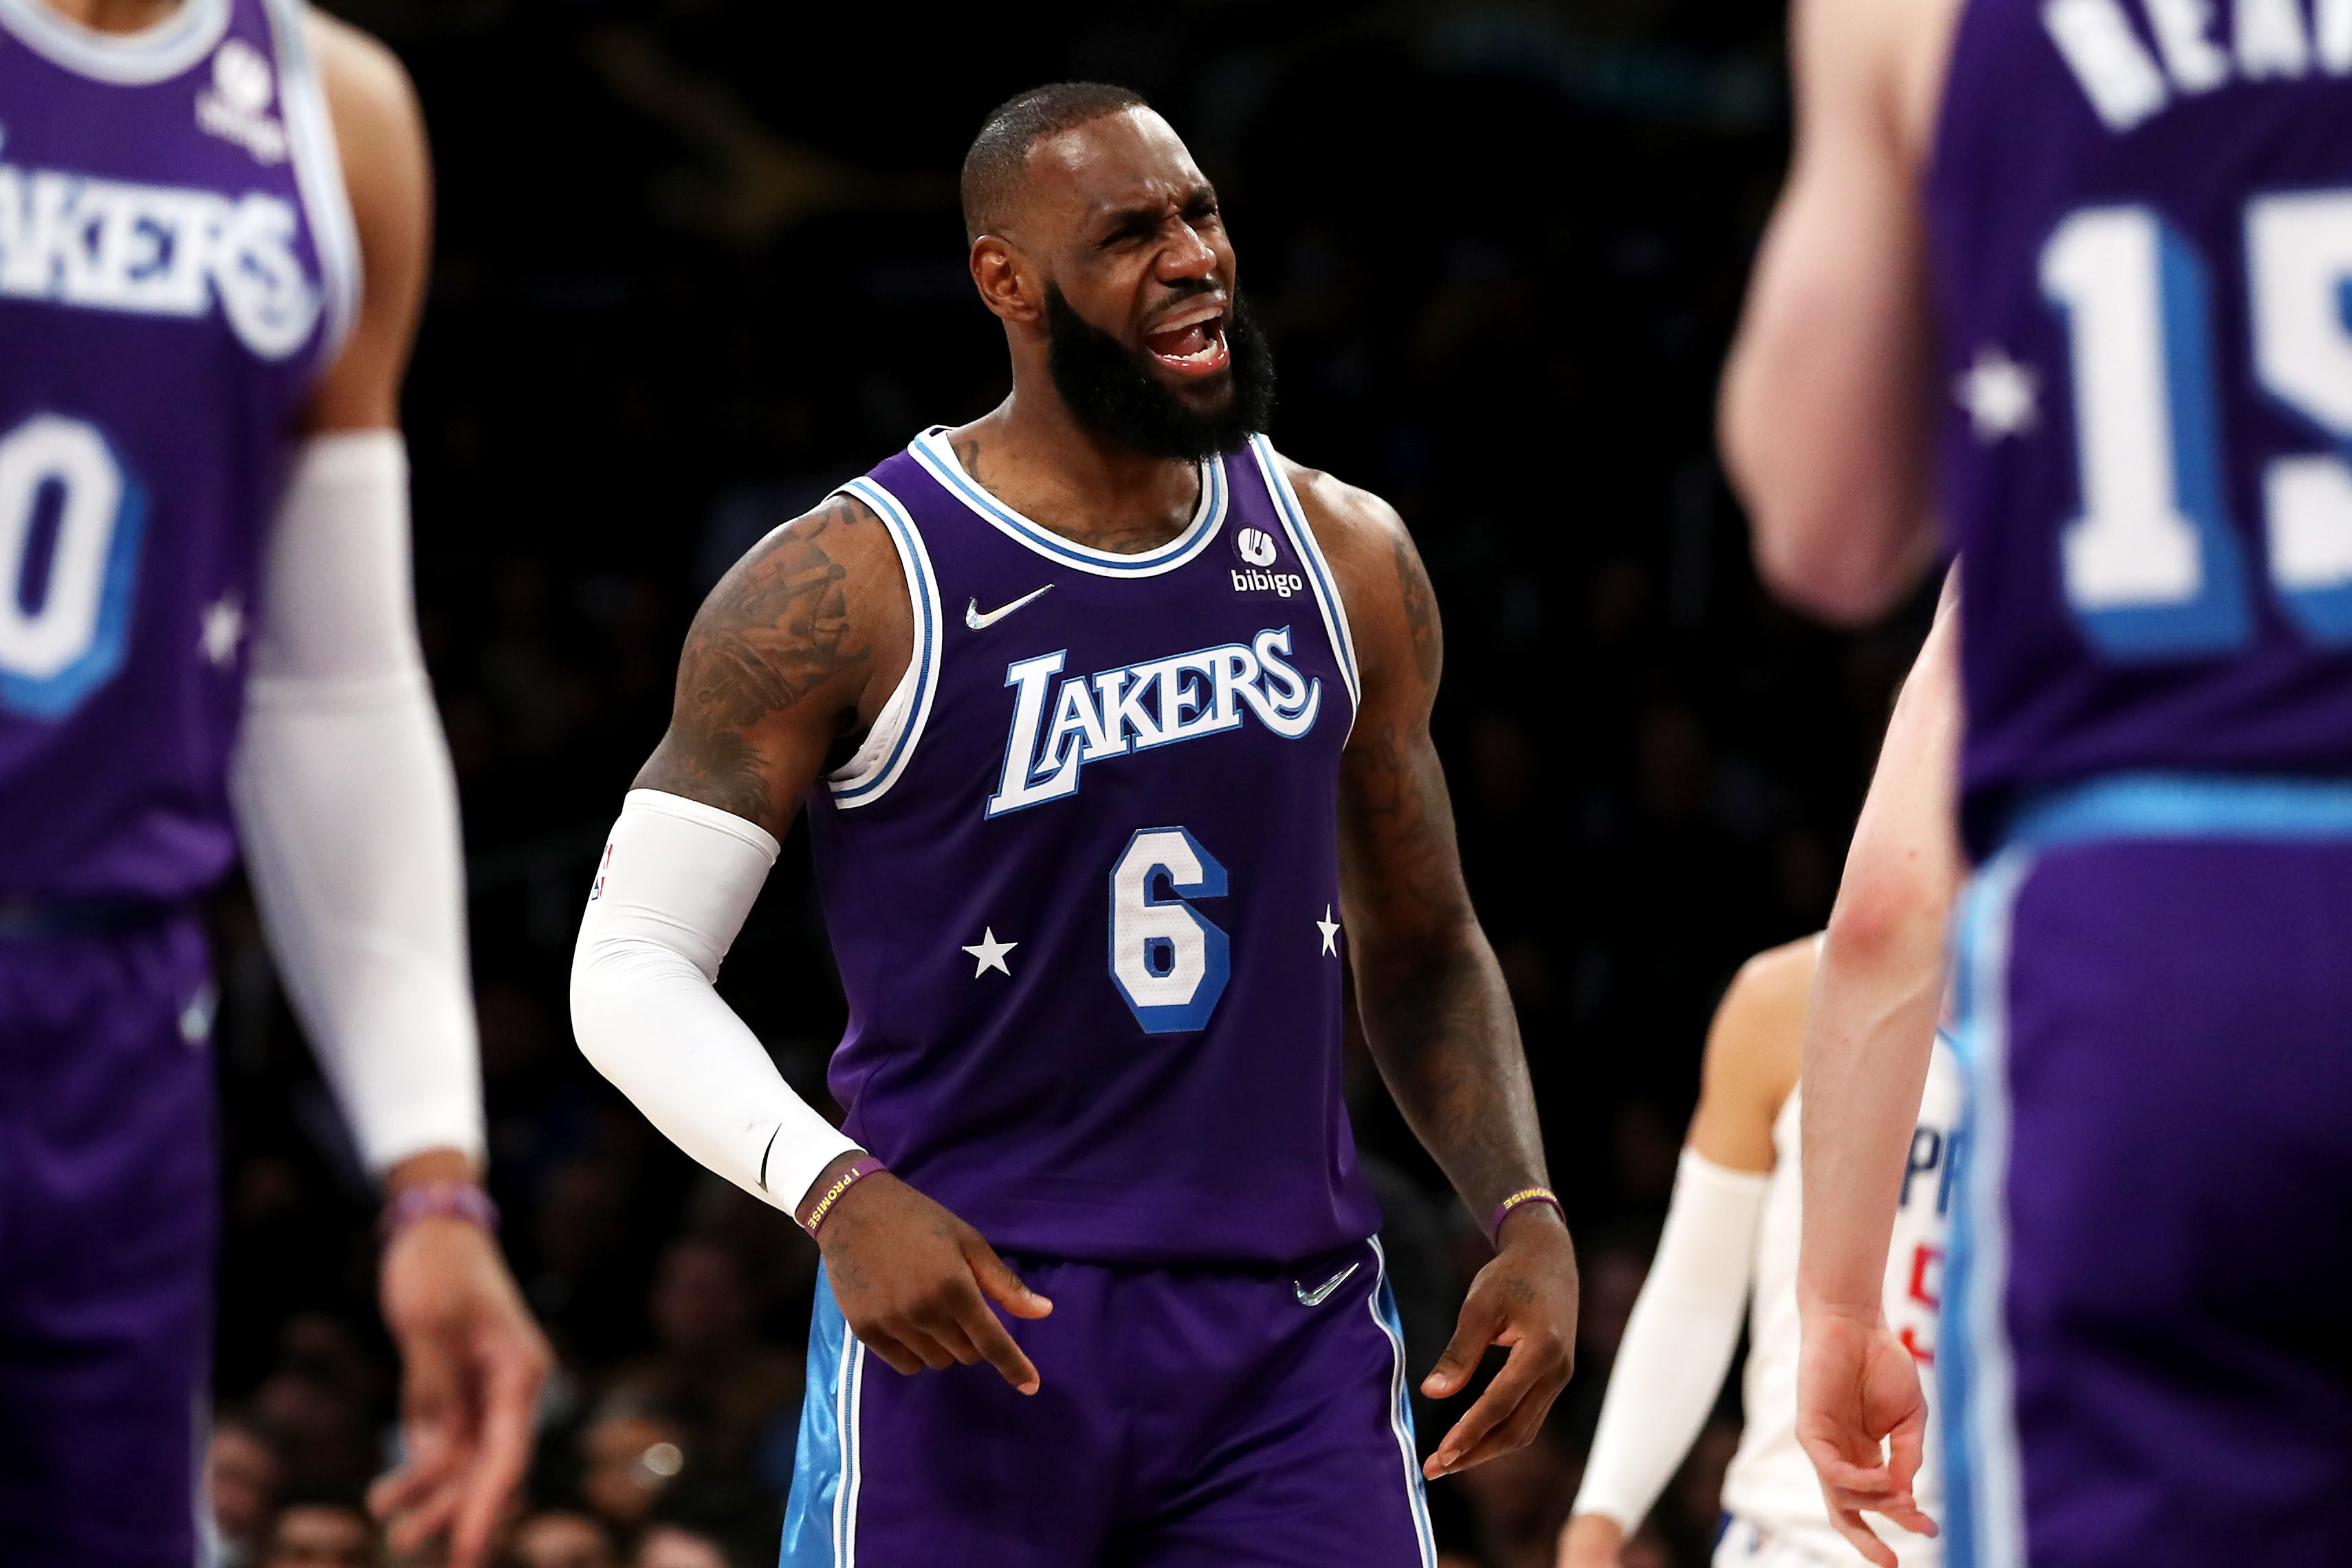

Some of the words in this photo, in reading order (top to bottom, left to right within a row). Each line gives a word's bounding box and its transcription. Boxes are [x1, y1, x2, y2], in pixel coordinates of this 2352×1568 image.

[1231, 569, 1303, 598] bibigo
[984, 624, 1321, 820] LAKERS
[1108, 826, 1231, 1034] 6
[851, 1168, 860, 1176] I
[808, 1174, 853, 1229] PROMISE
